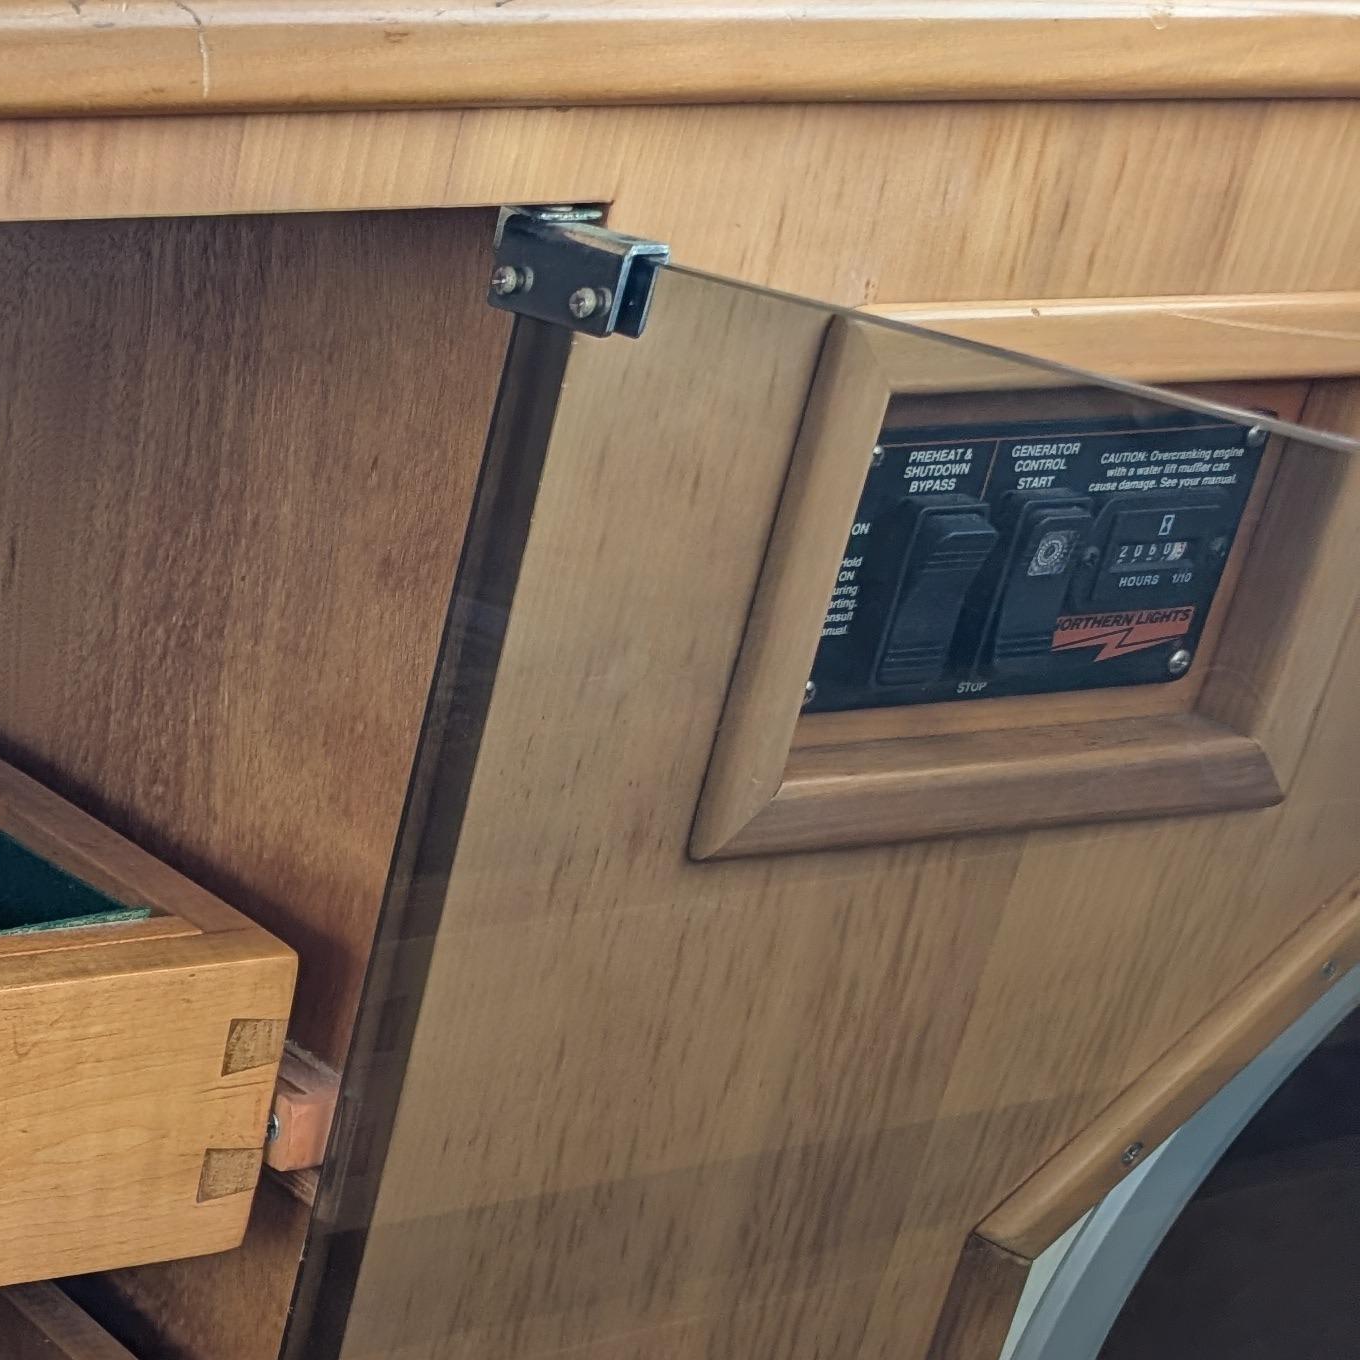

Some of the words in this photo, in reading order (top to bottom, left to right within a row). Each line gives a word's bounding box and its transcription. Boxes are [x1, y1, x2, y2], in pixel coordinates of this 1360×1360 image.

[909, 449, 961, 463] PREHEAT
[964, 448, 973, 460] &
[1011, 443, 1081, 457] GENERATOR
[1101, 452, 1147, 464] CAUTION:
[1150, 449, 1211, 461] Overcranking
[1213, 447, 1245, 460] engine
[904, 463, 971, 478] SHUTDOWN
[1014, 458, 1068, 472] CONTROL
[1106, 466, 1127, 477] with
[1128, 469, 1135, 477] a
[1136, 466, 1163, 476] water
[1163, 464, 1178, 474] lift
[1178, 462, 1211, 473] muffler
[1212, 463, 1230, 472] can
[909, 478, 957, 492] BYPASS
[1016, 476, 1056, 489] START
[1088, 482, 1116, 492] cause
[1118, 479, 1158, 491] damage.
[1160, 477, 1178, 488] See
[1178, 476, 1201, 488] your
[1201, 474, 1237, 485] manual.
[851, 523, 871, 535] ON
[839, 571, 856, 581] ON
[1119, 575, 1160, 587] HOURS
[1172, 573, 1192, 584] 1/10
[832, 585, 859, 597] uring
[1136, 609, 1193, 626] LIGHTS
[956, 681, 988, 694] STOP
